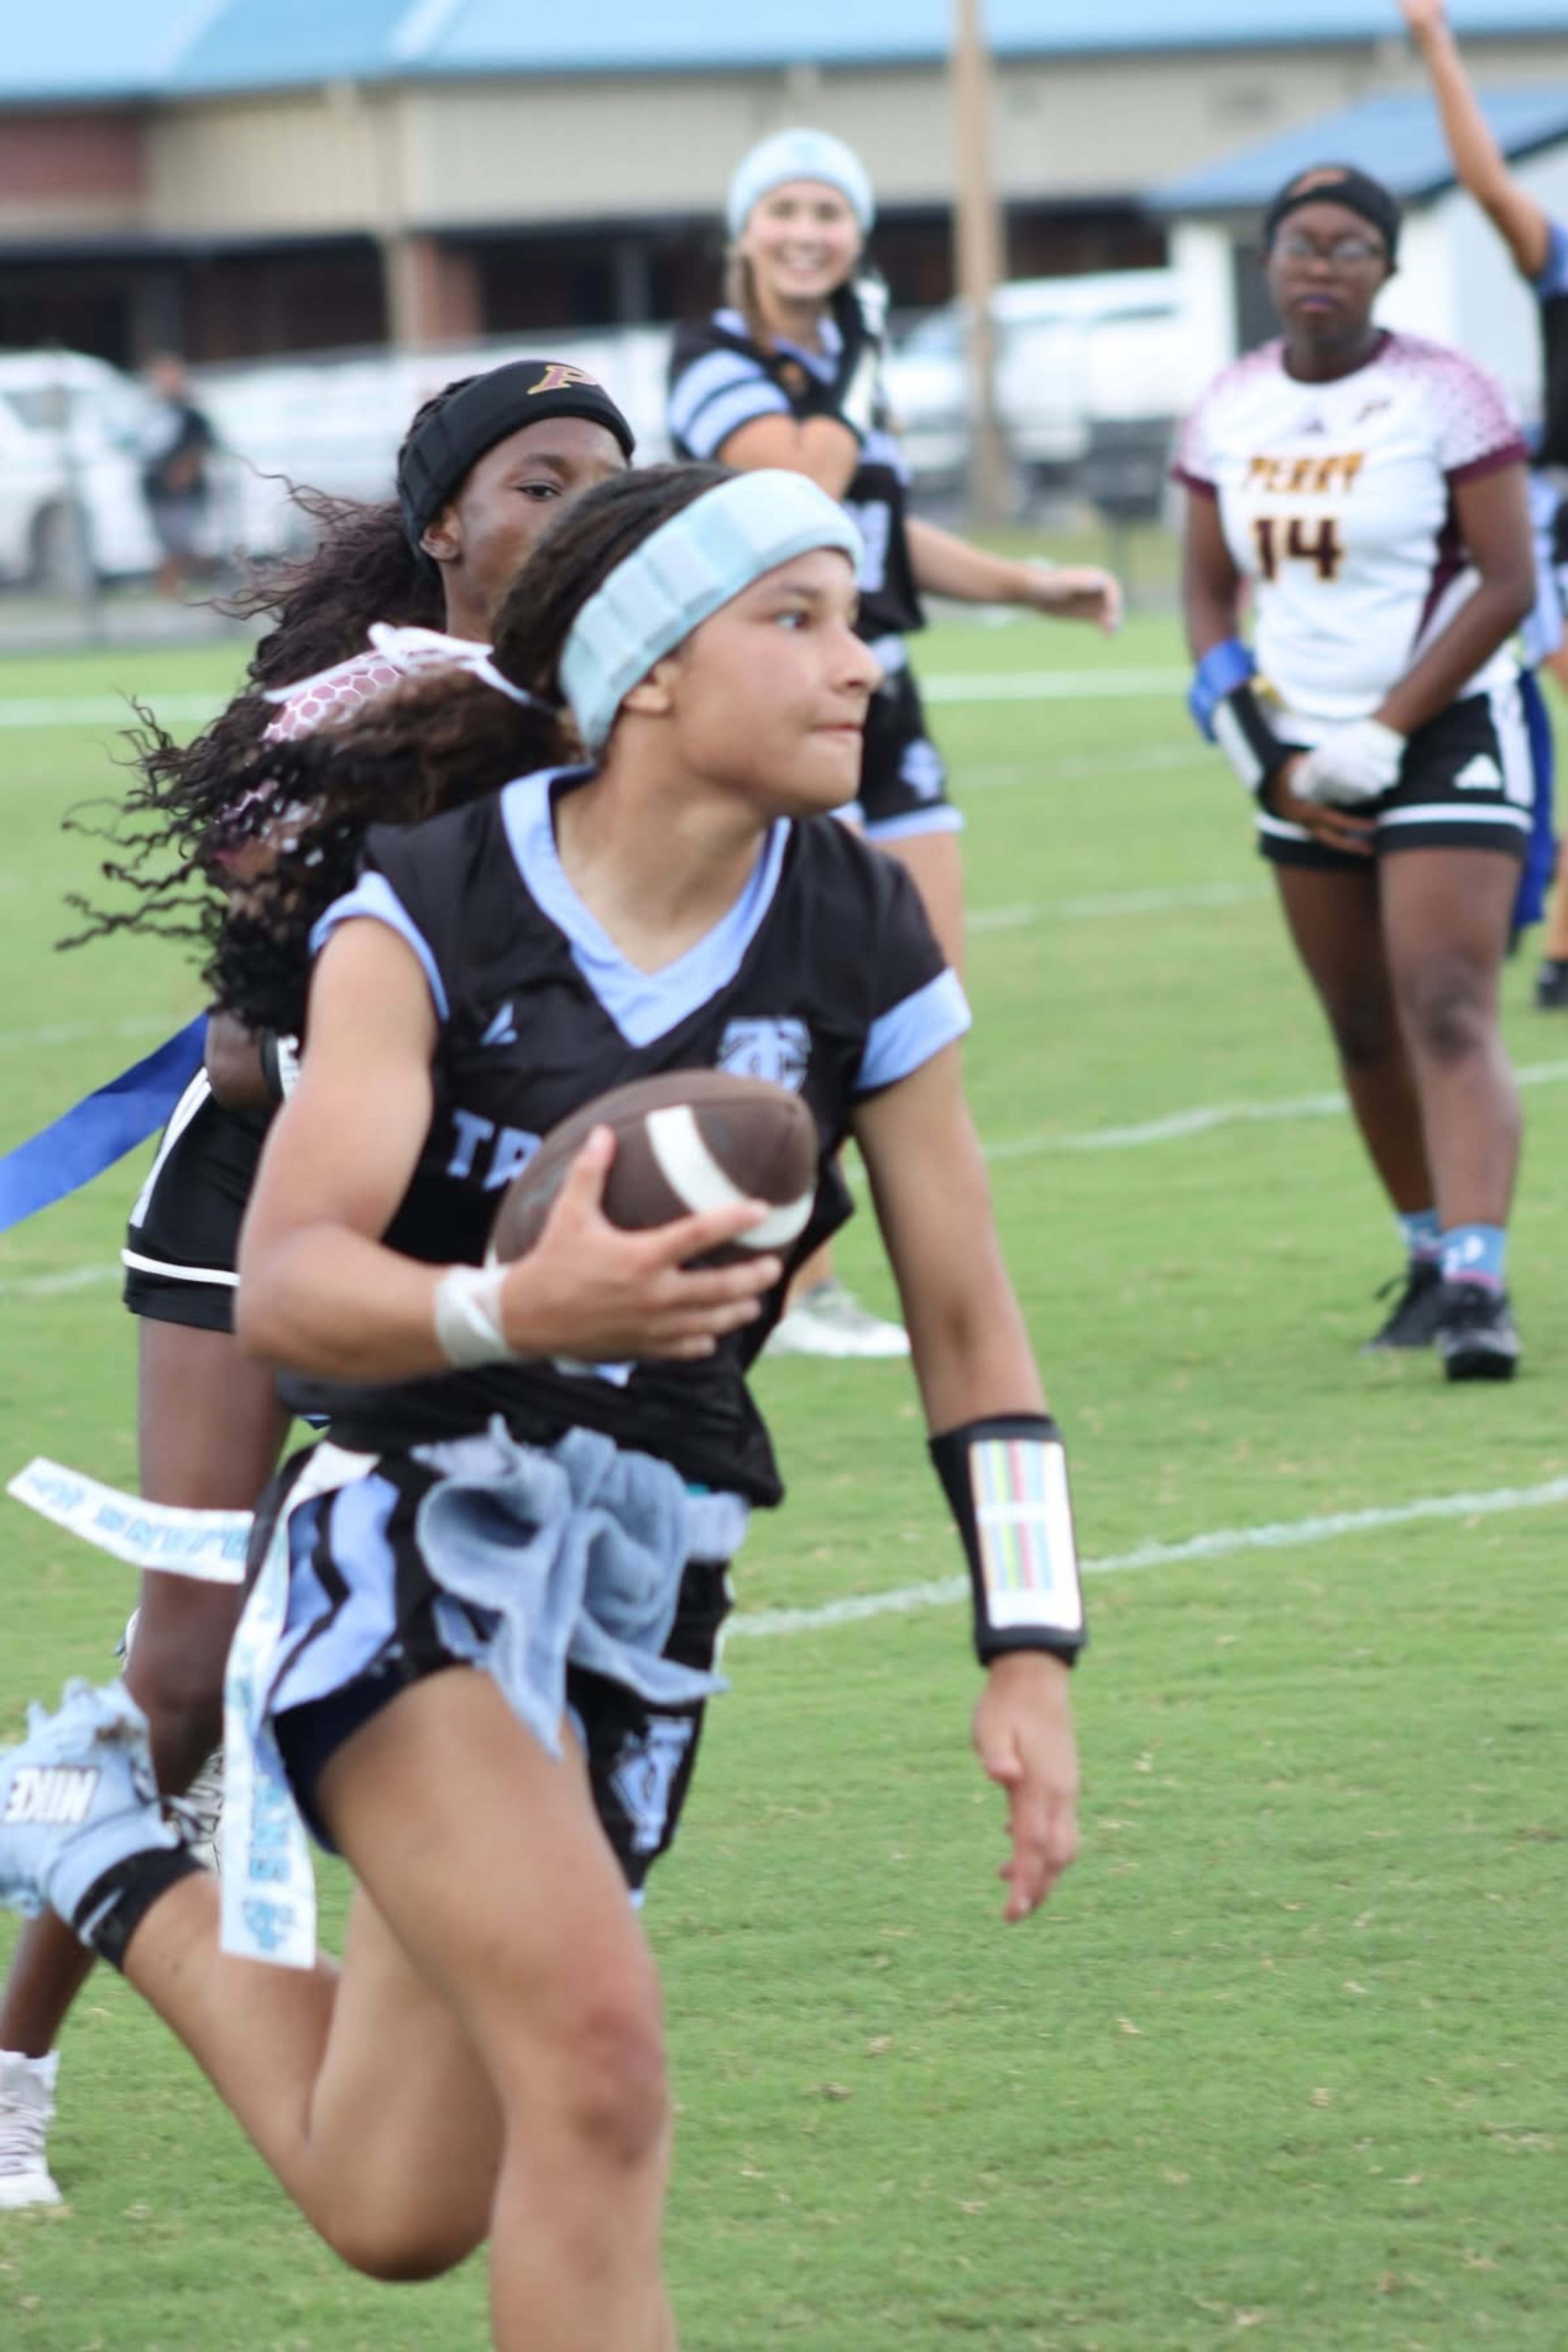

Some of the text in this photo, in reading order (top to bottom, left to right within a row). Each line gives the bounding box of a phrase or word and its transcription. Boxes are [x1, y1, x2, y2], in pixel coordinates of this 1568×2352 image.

[1242, 450, 1365, 494] PERRY
[1251, 514, 1345, 585] 14
[4, 1765, 100, 1824] NIKE
